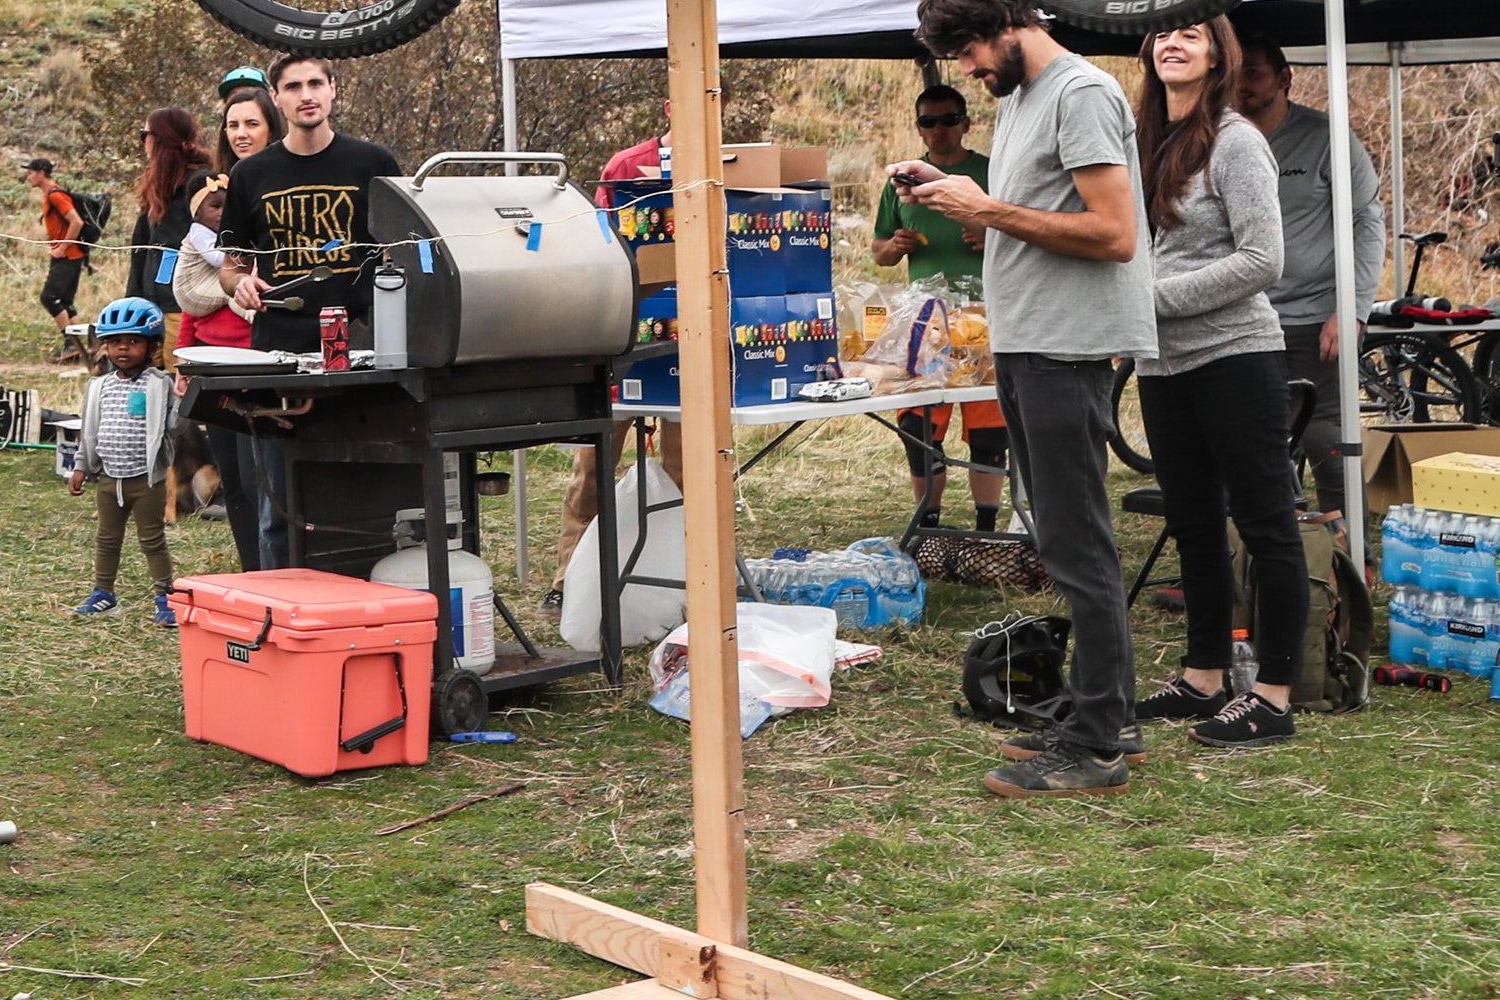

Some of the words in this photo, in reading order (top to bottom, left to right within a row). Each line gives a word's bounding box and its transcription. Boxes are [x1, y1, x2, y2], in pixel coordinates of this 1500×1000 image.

[357, 0, 395, 21] 1700
[1105, 2, 1150, 15] BIG
[274, 22, 317, 40] BIG
[319, 12, 396, 41] BETTY
[265, 190, 355, 245] NITRO
[737, 239, 758, 249] Classic
[789, 236, 809, 246] Classic
[809, 236, 820, 246] Mix
[744, 349, 764, 360] Classic
[764, 349, 775, 359] Mix
[1441, 533, 1475, 544] KIRKLAND
[1449, 622, 1484, 633] KIRKLAND
[227, 643, 249, 661] YETI
